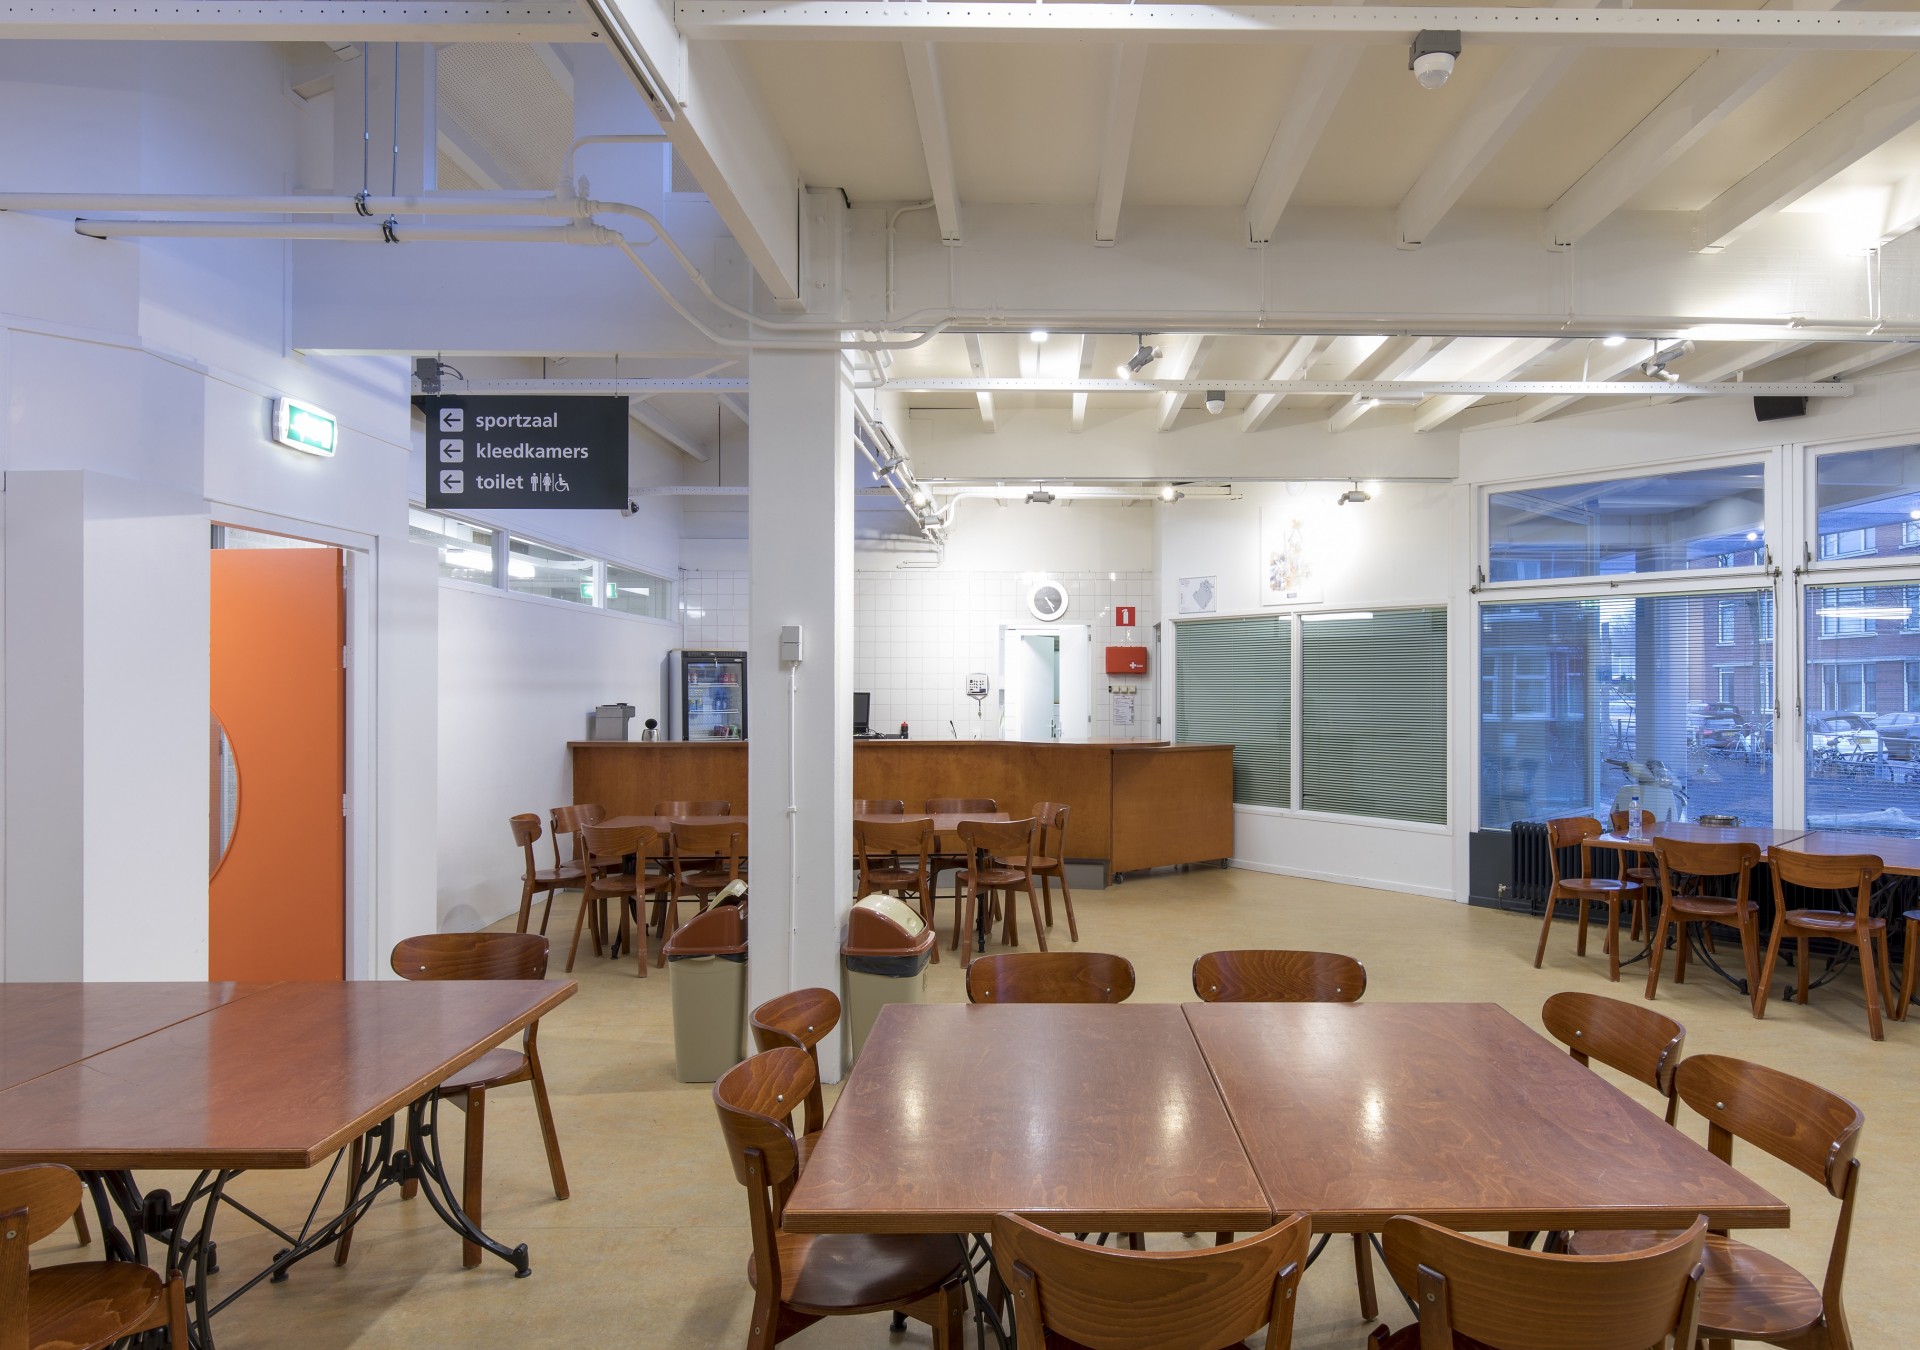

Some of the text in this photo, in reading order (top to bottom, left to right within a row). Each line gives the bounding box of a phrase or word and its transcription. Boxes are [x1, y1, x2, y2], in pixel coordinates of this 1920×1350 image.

[475, 412, 558, 432] sportzaal
[476, 442, 589, 459] kleedkamers
[475, 473, 524, 490] toilet
